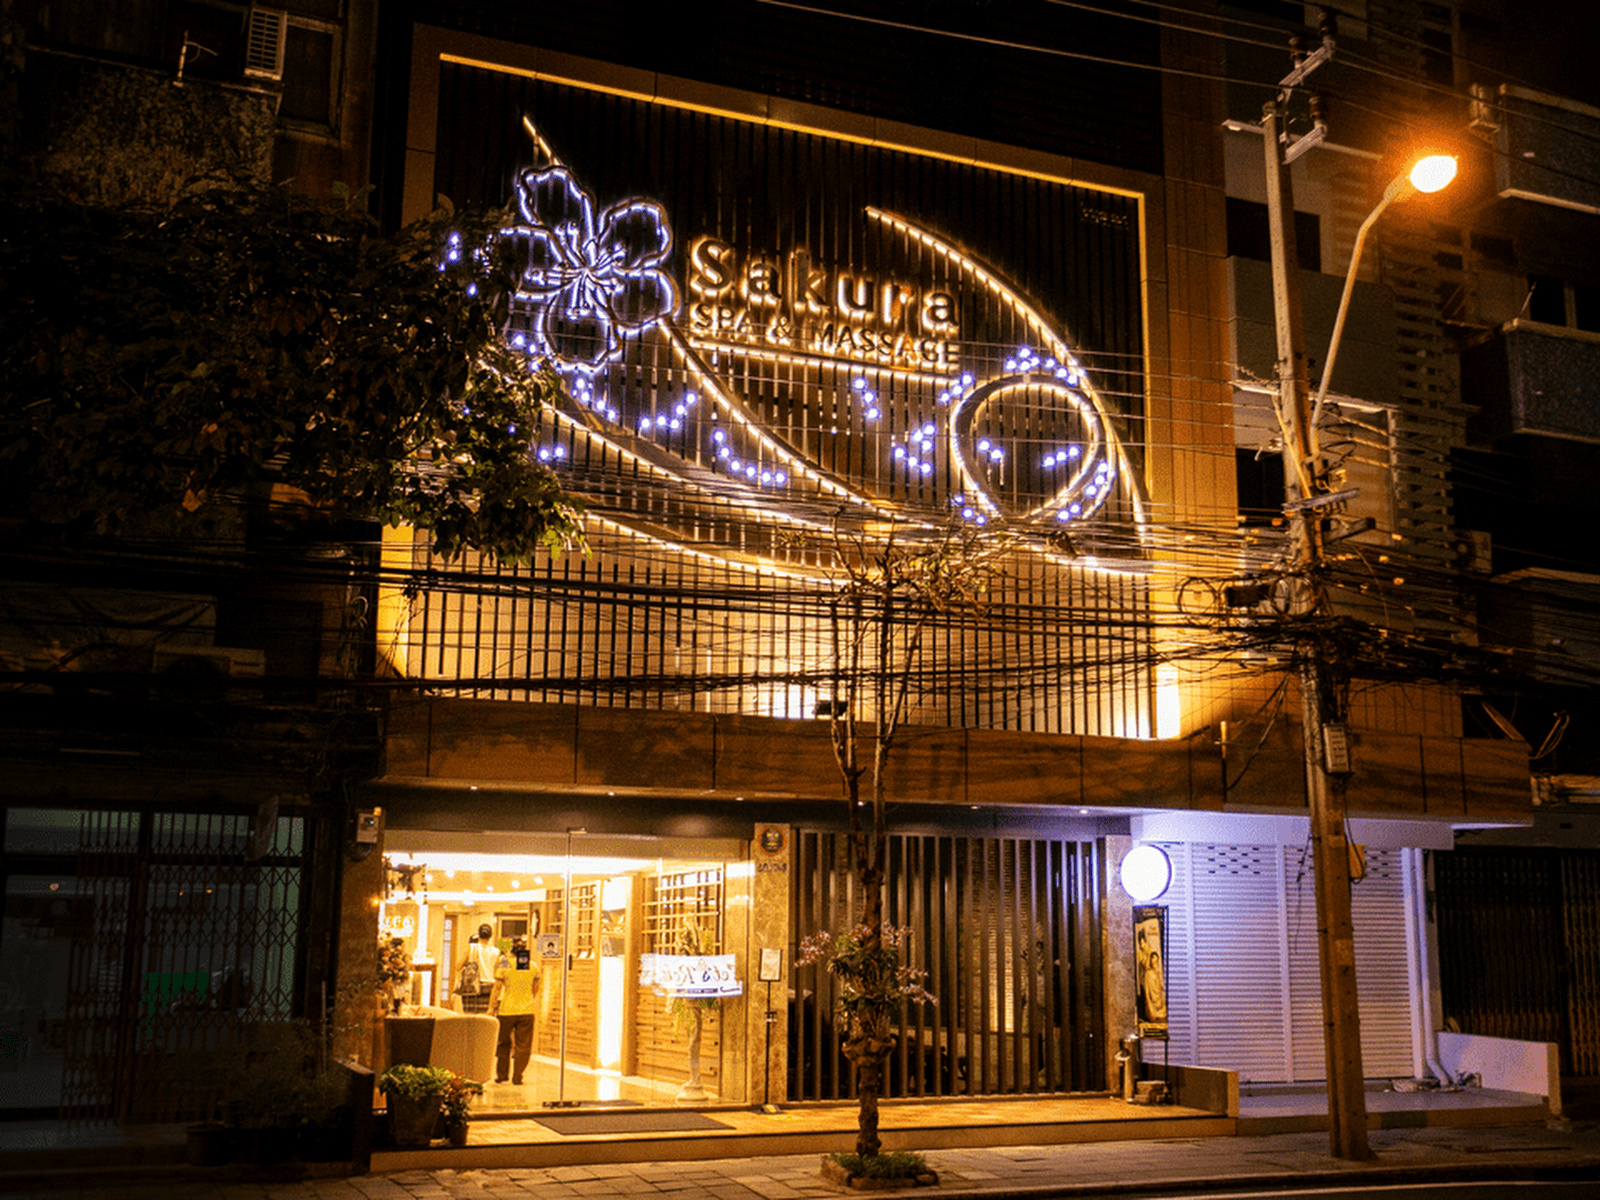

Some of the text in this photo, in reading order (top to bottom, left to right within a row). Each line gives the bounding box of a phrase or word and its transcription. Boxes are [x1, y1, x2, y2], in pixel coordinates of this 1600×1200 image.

[690, 237, 959, 332] Sakura
[690, 303, 959, 370] SPA & MASSAGE
